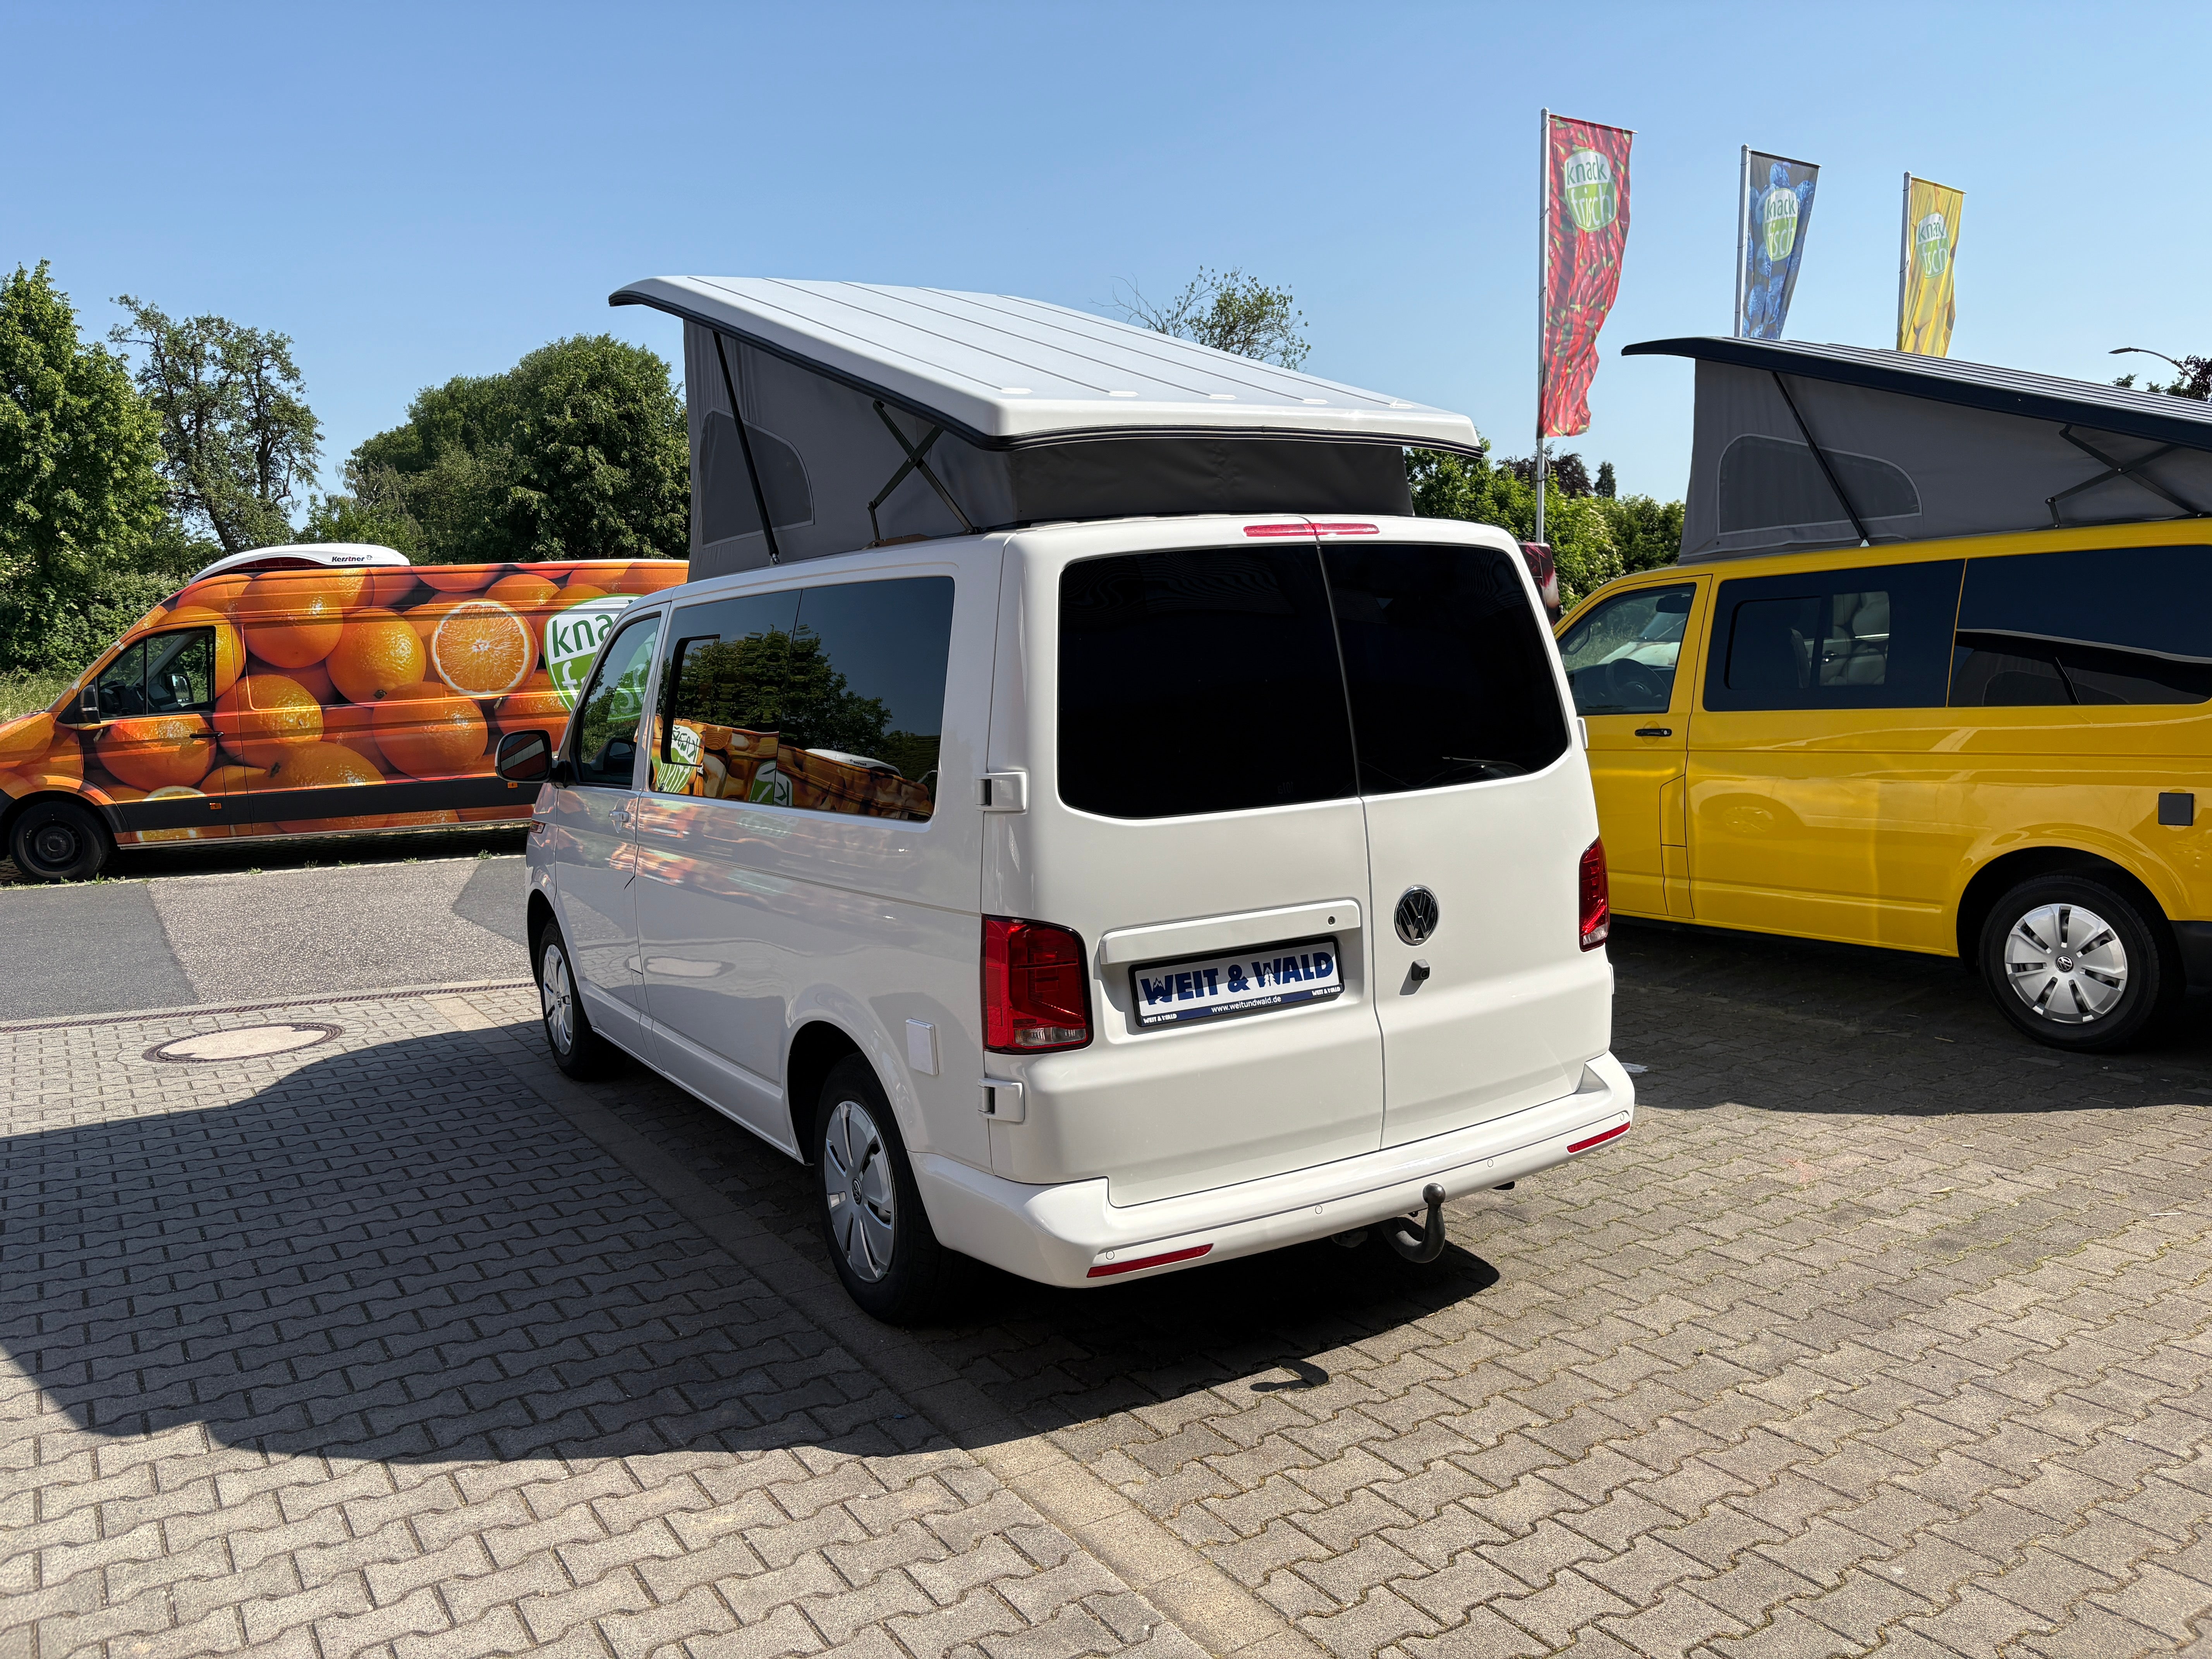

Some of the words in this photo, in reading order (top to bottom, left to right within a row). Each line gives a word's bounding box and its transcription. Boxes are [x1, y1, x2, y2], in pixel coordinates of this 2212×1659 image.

[1566, 155, 1608, 185] knack
[1571, 184, 1612, 228] frisch
[552, 614, 614, 658] kna
[1140, 967, 1219, 1005] WEIT
[1228, 964, 1251, 993] &
[1251, 951, 1334, 988] WALD
[1211, 995, 1281, 1013] www.weitundwald.de
